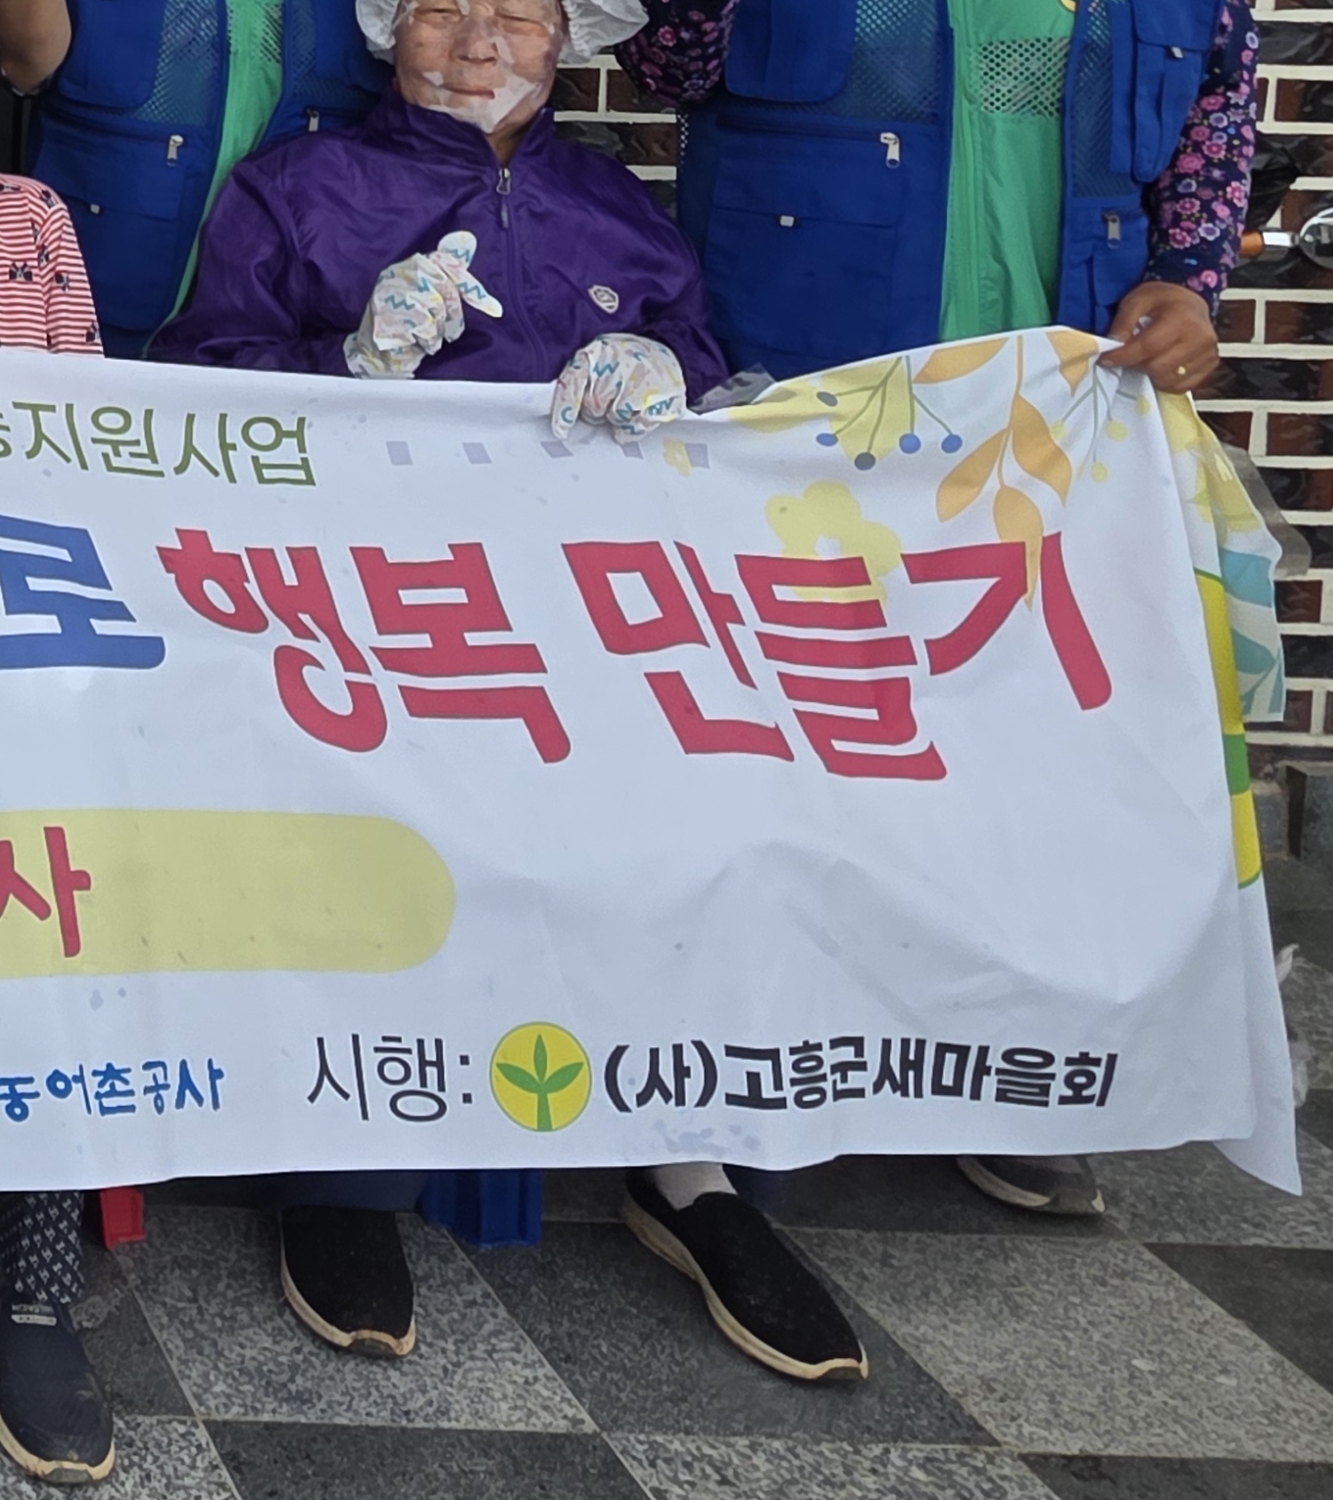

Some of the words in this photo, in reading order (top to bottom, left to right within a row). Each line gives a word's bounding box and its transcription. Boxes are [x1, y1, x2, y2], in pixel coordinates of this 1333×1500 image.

[155, 528, 571, 764] 행복
[562, 533, 1111, 780] 만들기
[308, 1034, 472, 1121] 시행:
[605, 1037, 1118, 1112] (사)고흥군새마을회
